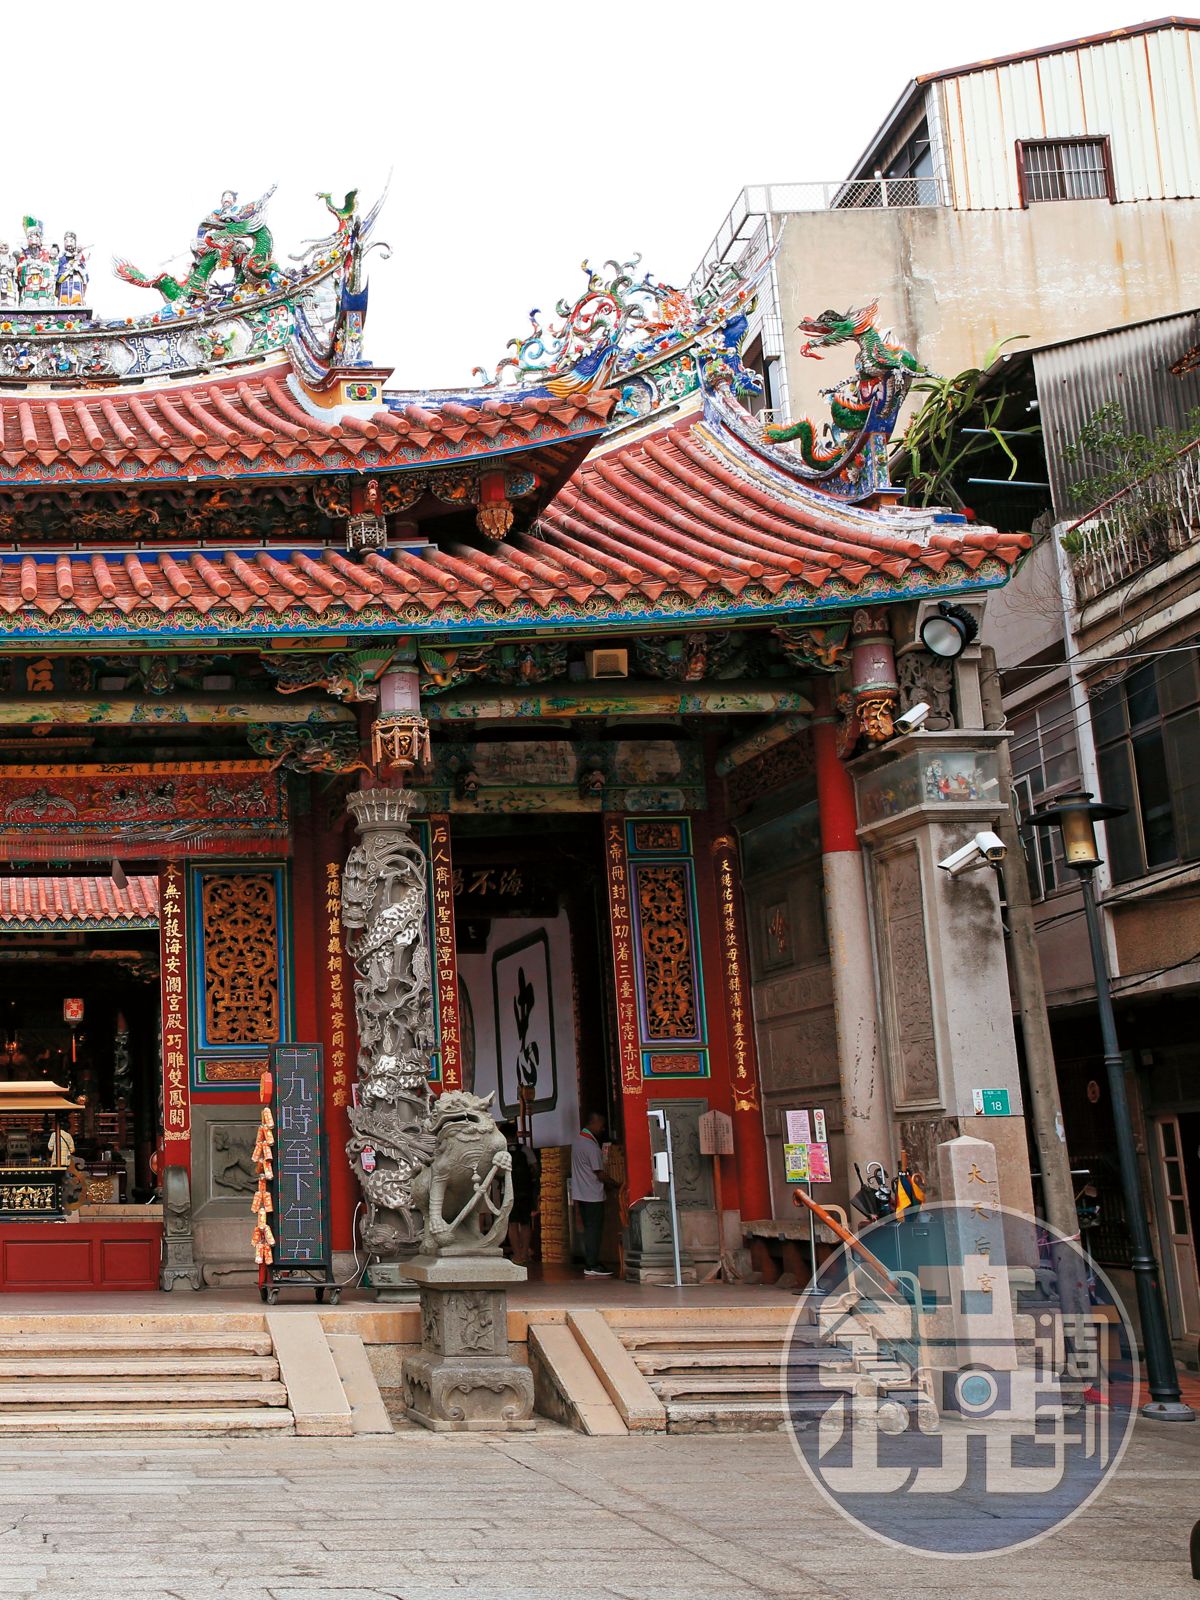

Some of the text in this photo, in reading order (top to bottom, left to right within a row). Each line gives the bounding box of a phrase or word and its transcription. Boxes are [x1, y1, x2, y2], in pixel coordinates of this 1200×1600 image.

[163, 859, 186, 1128] 本無私護海安瀾宮殿巧雕雙鳳闕
[991, 1101, 1003, 1112] 18
[967, 1163, 999, 1295] 大天后宮
